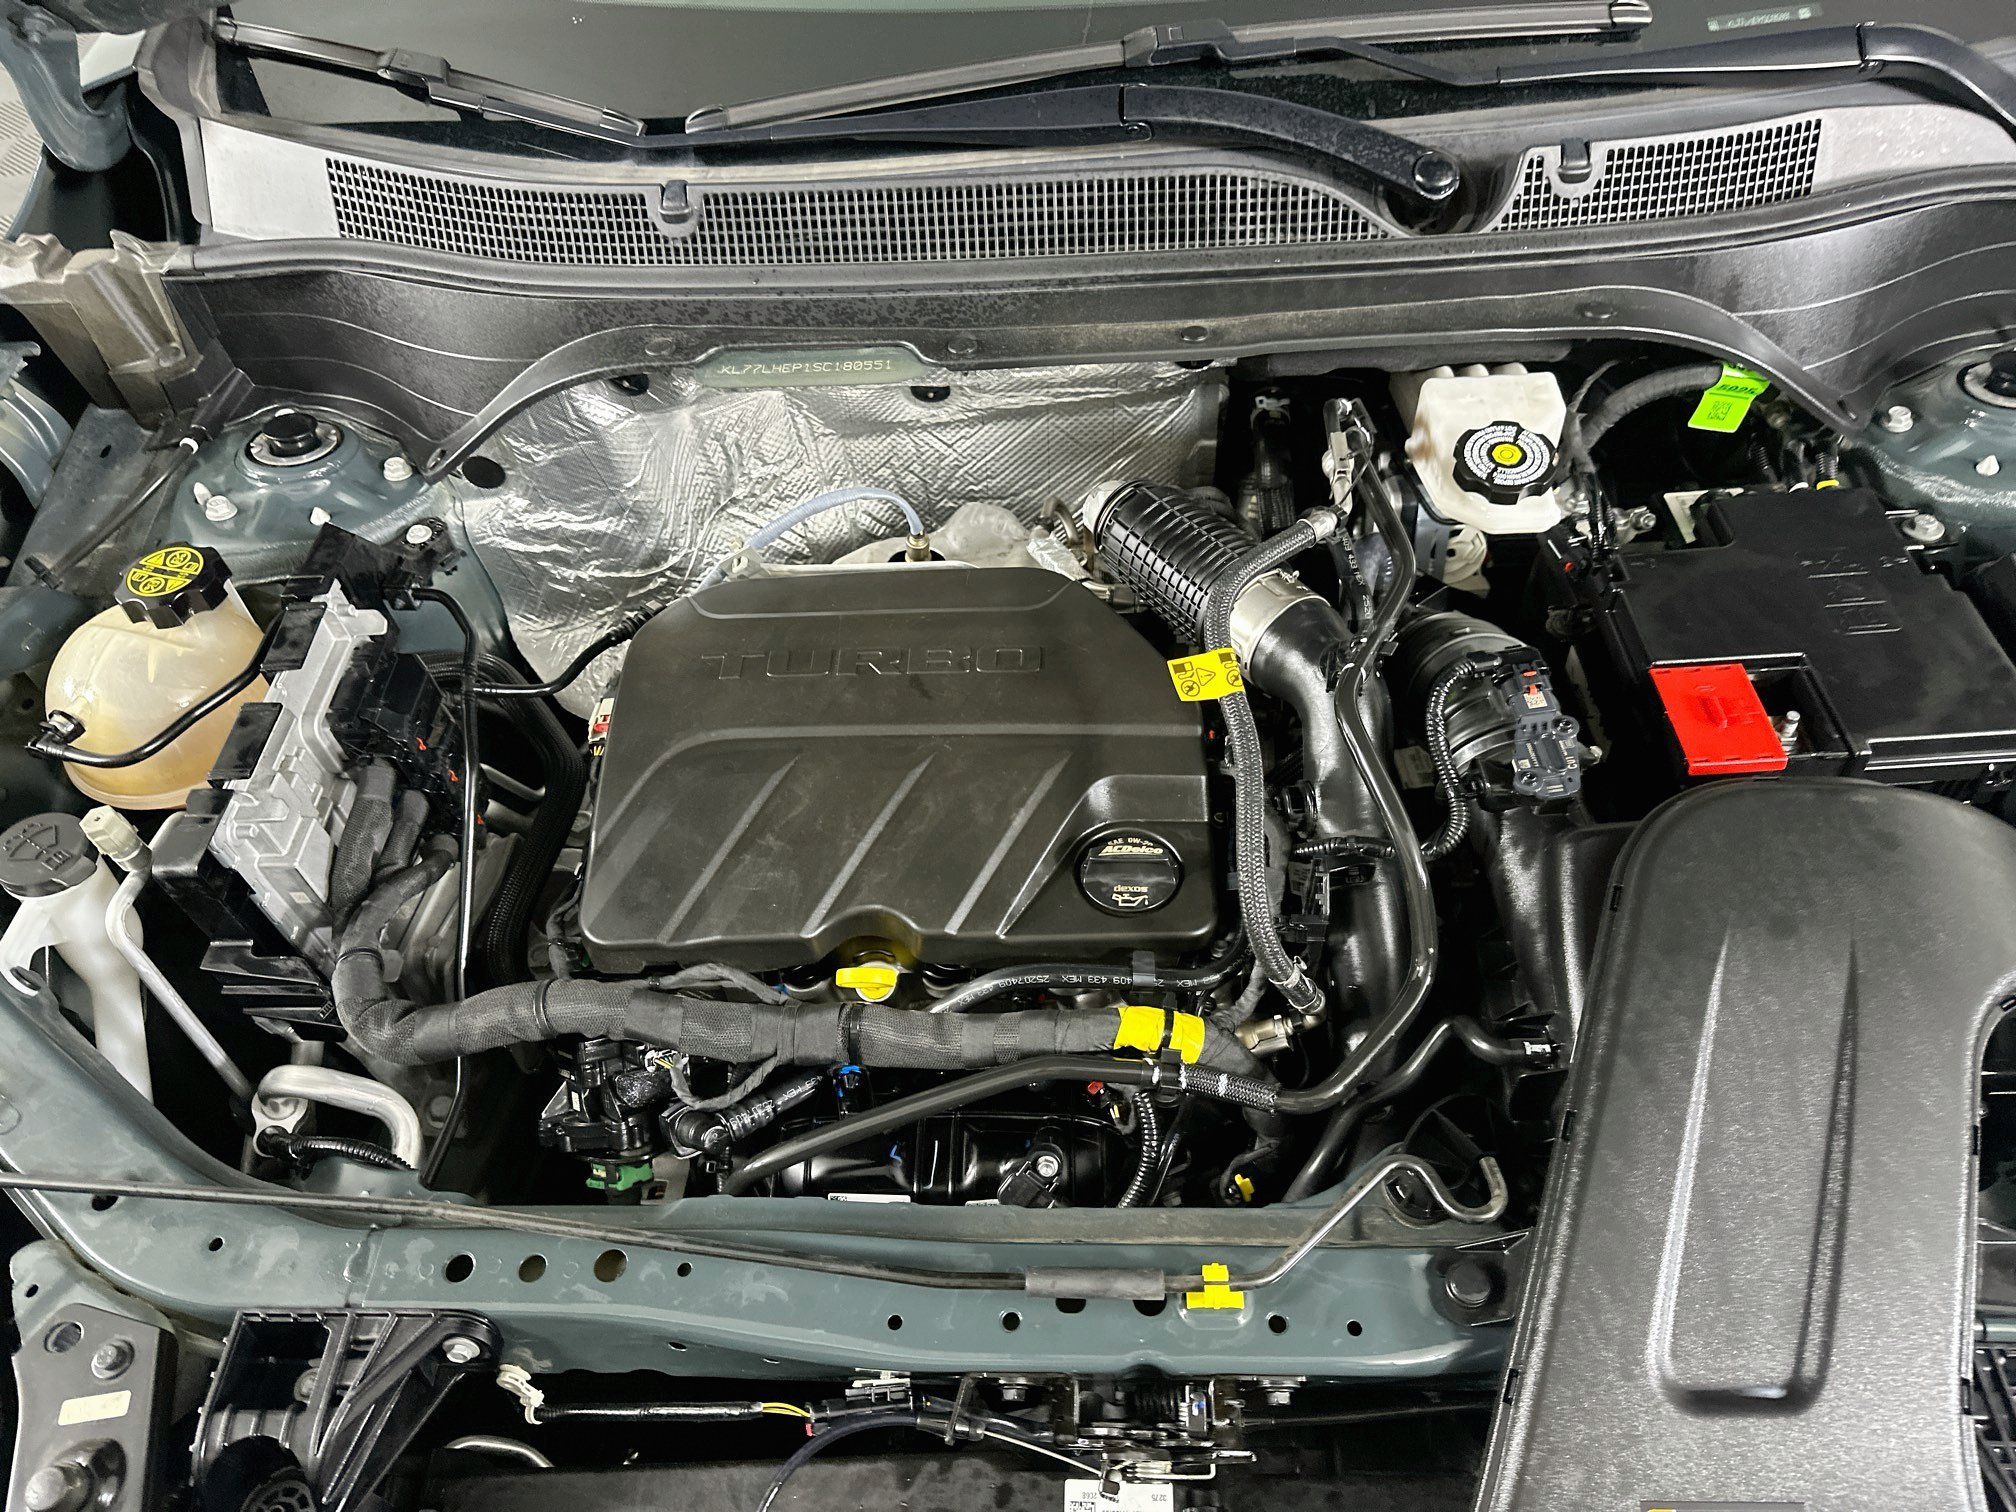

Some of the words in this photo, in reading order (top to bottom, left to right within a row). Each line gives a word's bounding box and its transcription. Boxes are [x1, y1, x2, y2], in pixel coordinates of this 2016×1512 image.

[701, 648, 1045, 679] TURBO
[1099, 845, 1163, 856] ACDelco
[1114, 885, 1148, 893] dexos
[999, 975, 1050, 989] 25207409
[1062, 975, 1082, 983] MEX
[1087, 976, 1107, 985] 433
